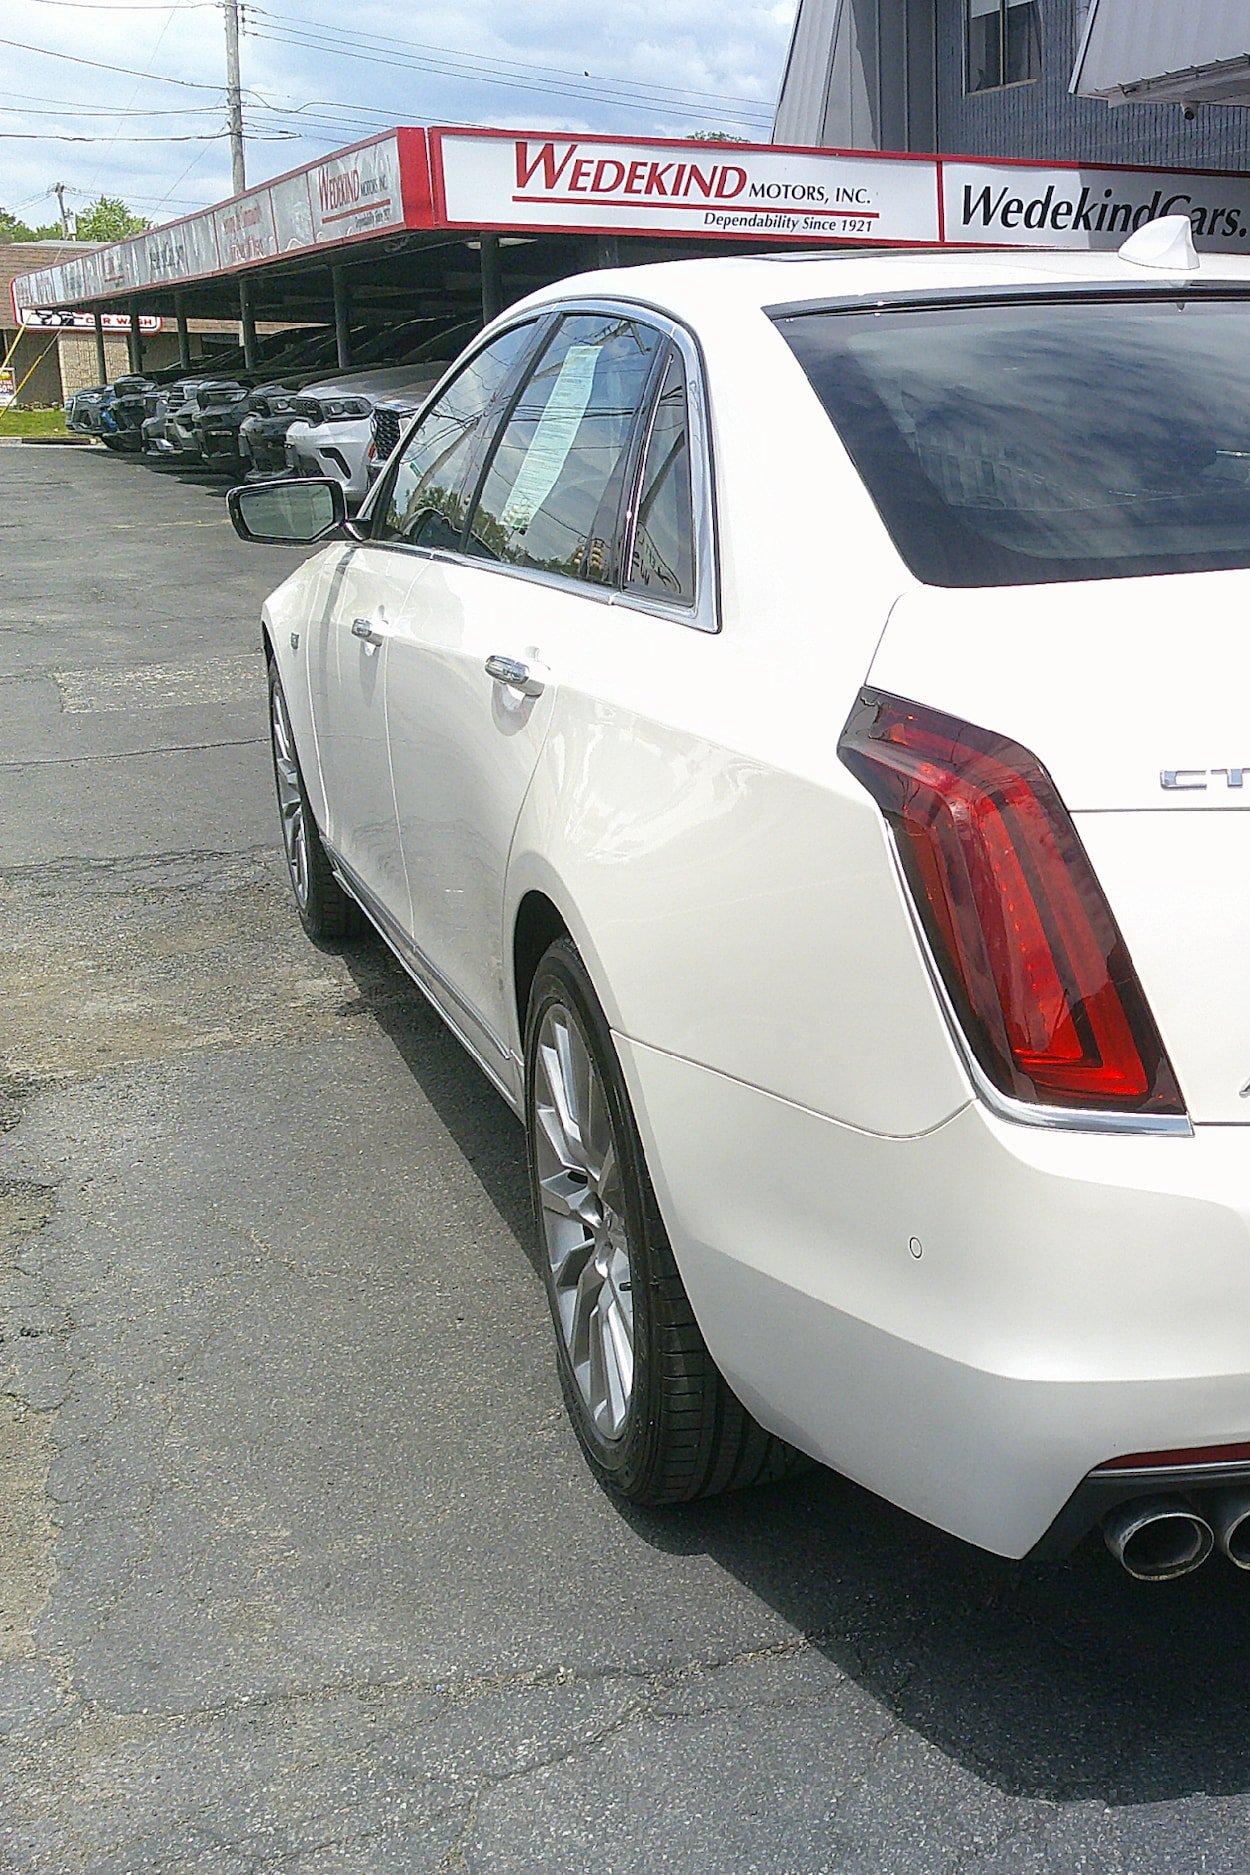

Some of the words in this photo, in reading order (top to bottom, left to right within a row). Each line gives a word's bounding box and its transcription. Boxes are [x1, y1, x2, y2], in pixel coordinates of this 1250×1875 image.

[515, 142, 748, 199] WEDEKIND
[749, 183, 829, 205] MOTORS,
[836, 187, 871, 204] INC.
[704, 212, 799, 232] Dependability
[802, 217, 837, 231] Since
[841, 219, 873, 232] 1921
